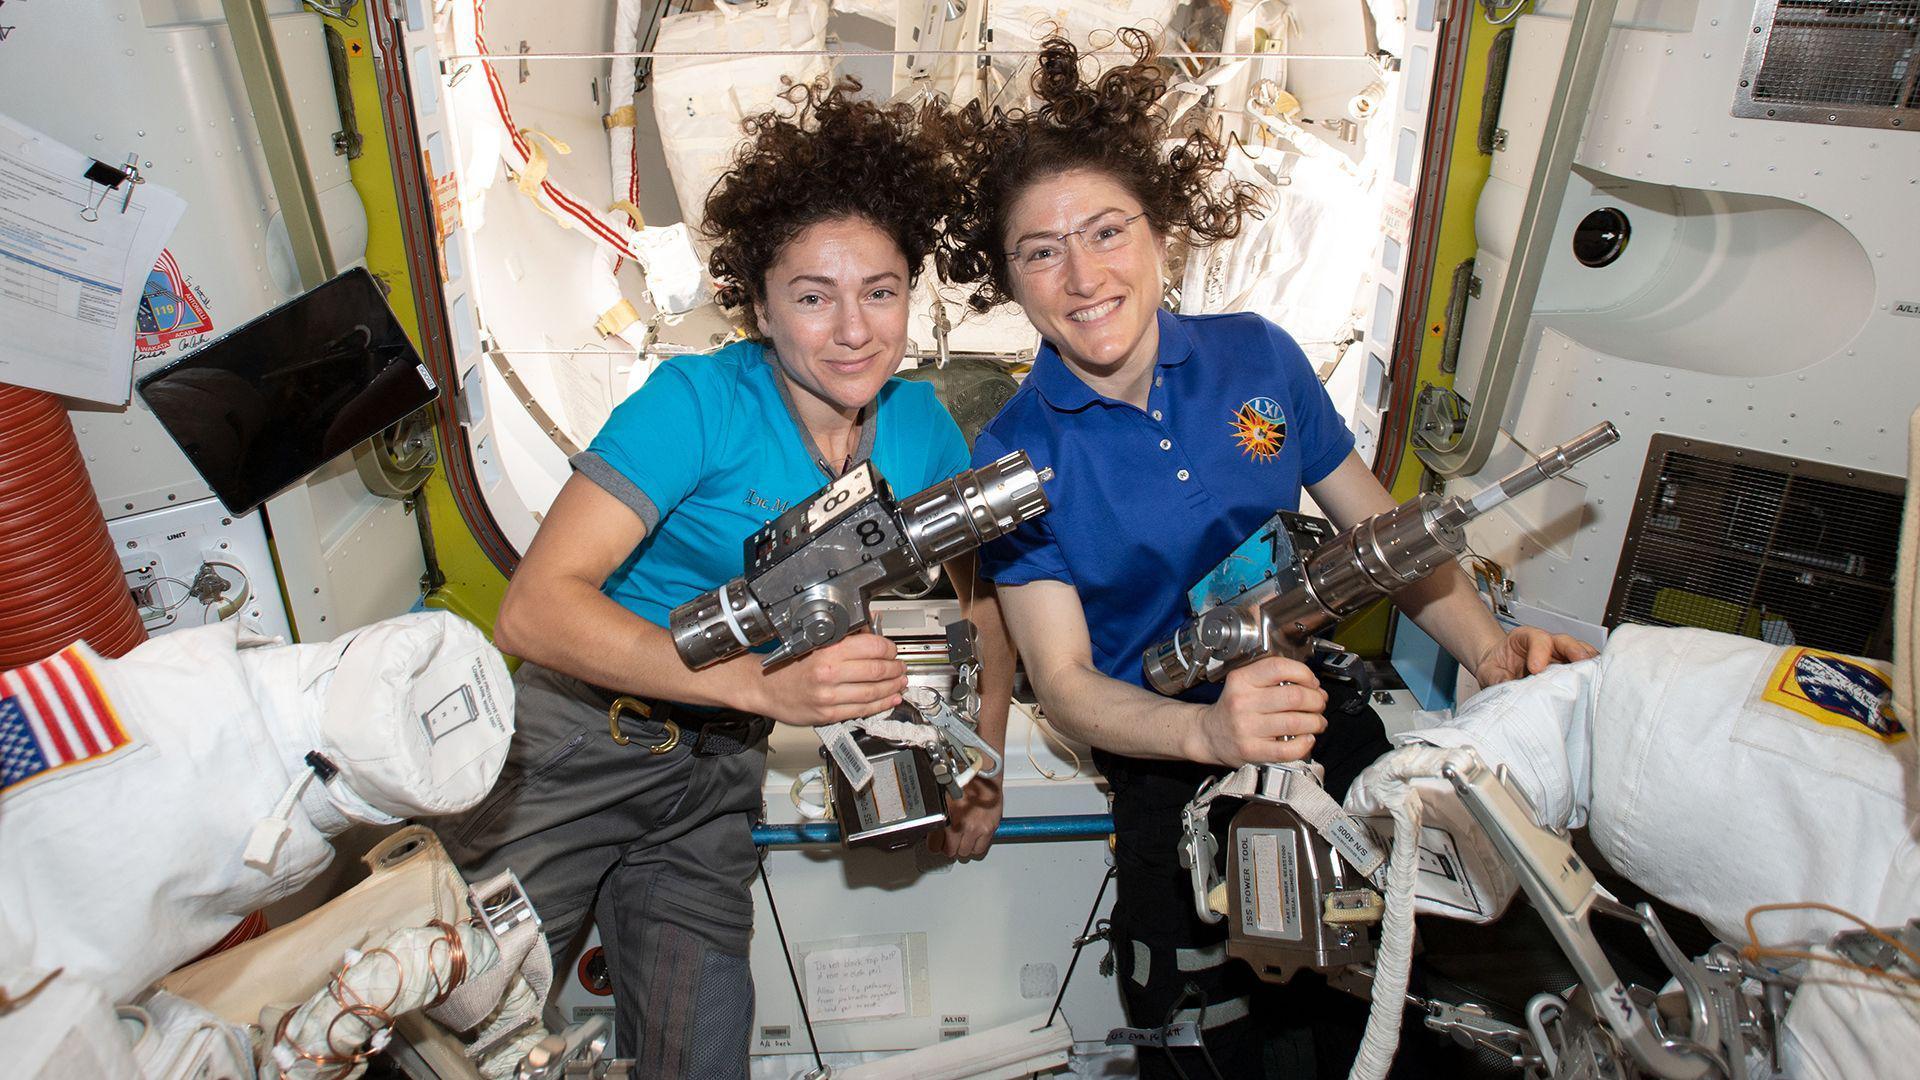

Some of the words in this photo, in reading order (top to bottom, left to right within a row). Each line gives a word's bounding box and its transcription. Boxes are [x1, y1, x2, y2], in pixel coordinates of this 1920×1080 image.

[155, 304, 175, 316] 119
[185, 293, 208, 320] ANTONELLI
[175, 330, 197, 338] ACABA
[140, 342, 170, 352] WAKATA
[1254, 400, 1278, 418] LXI
[823, 489, 850, 513] 8
[166, 531, 186, 541] UNIT
[856, 519, 886, 547] 8
[1260, 529, 1277, 564] 7
[1337, 825, 1356, 843] 4005
[1241, 837, 1249, 862] TOOL
[1353, 841, 1368, 857] S/N
[1242, 868, 1251, 903] POWER
[1246, 909, 1254, 926] ISS
[843, 958, 863, 968] block
[817, 986, 835, 995] Allow
[1111, 1031, 1124, 1040] US
[1128, 1032, 1145, 1041] EVA
